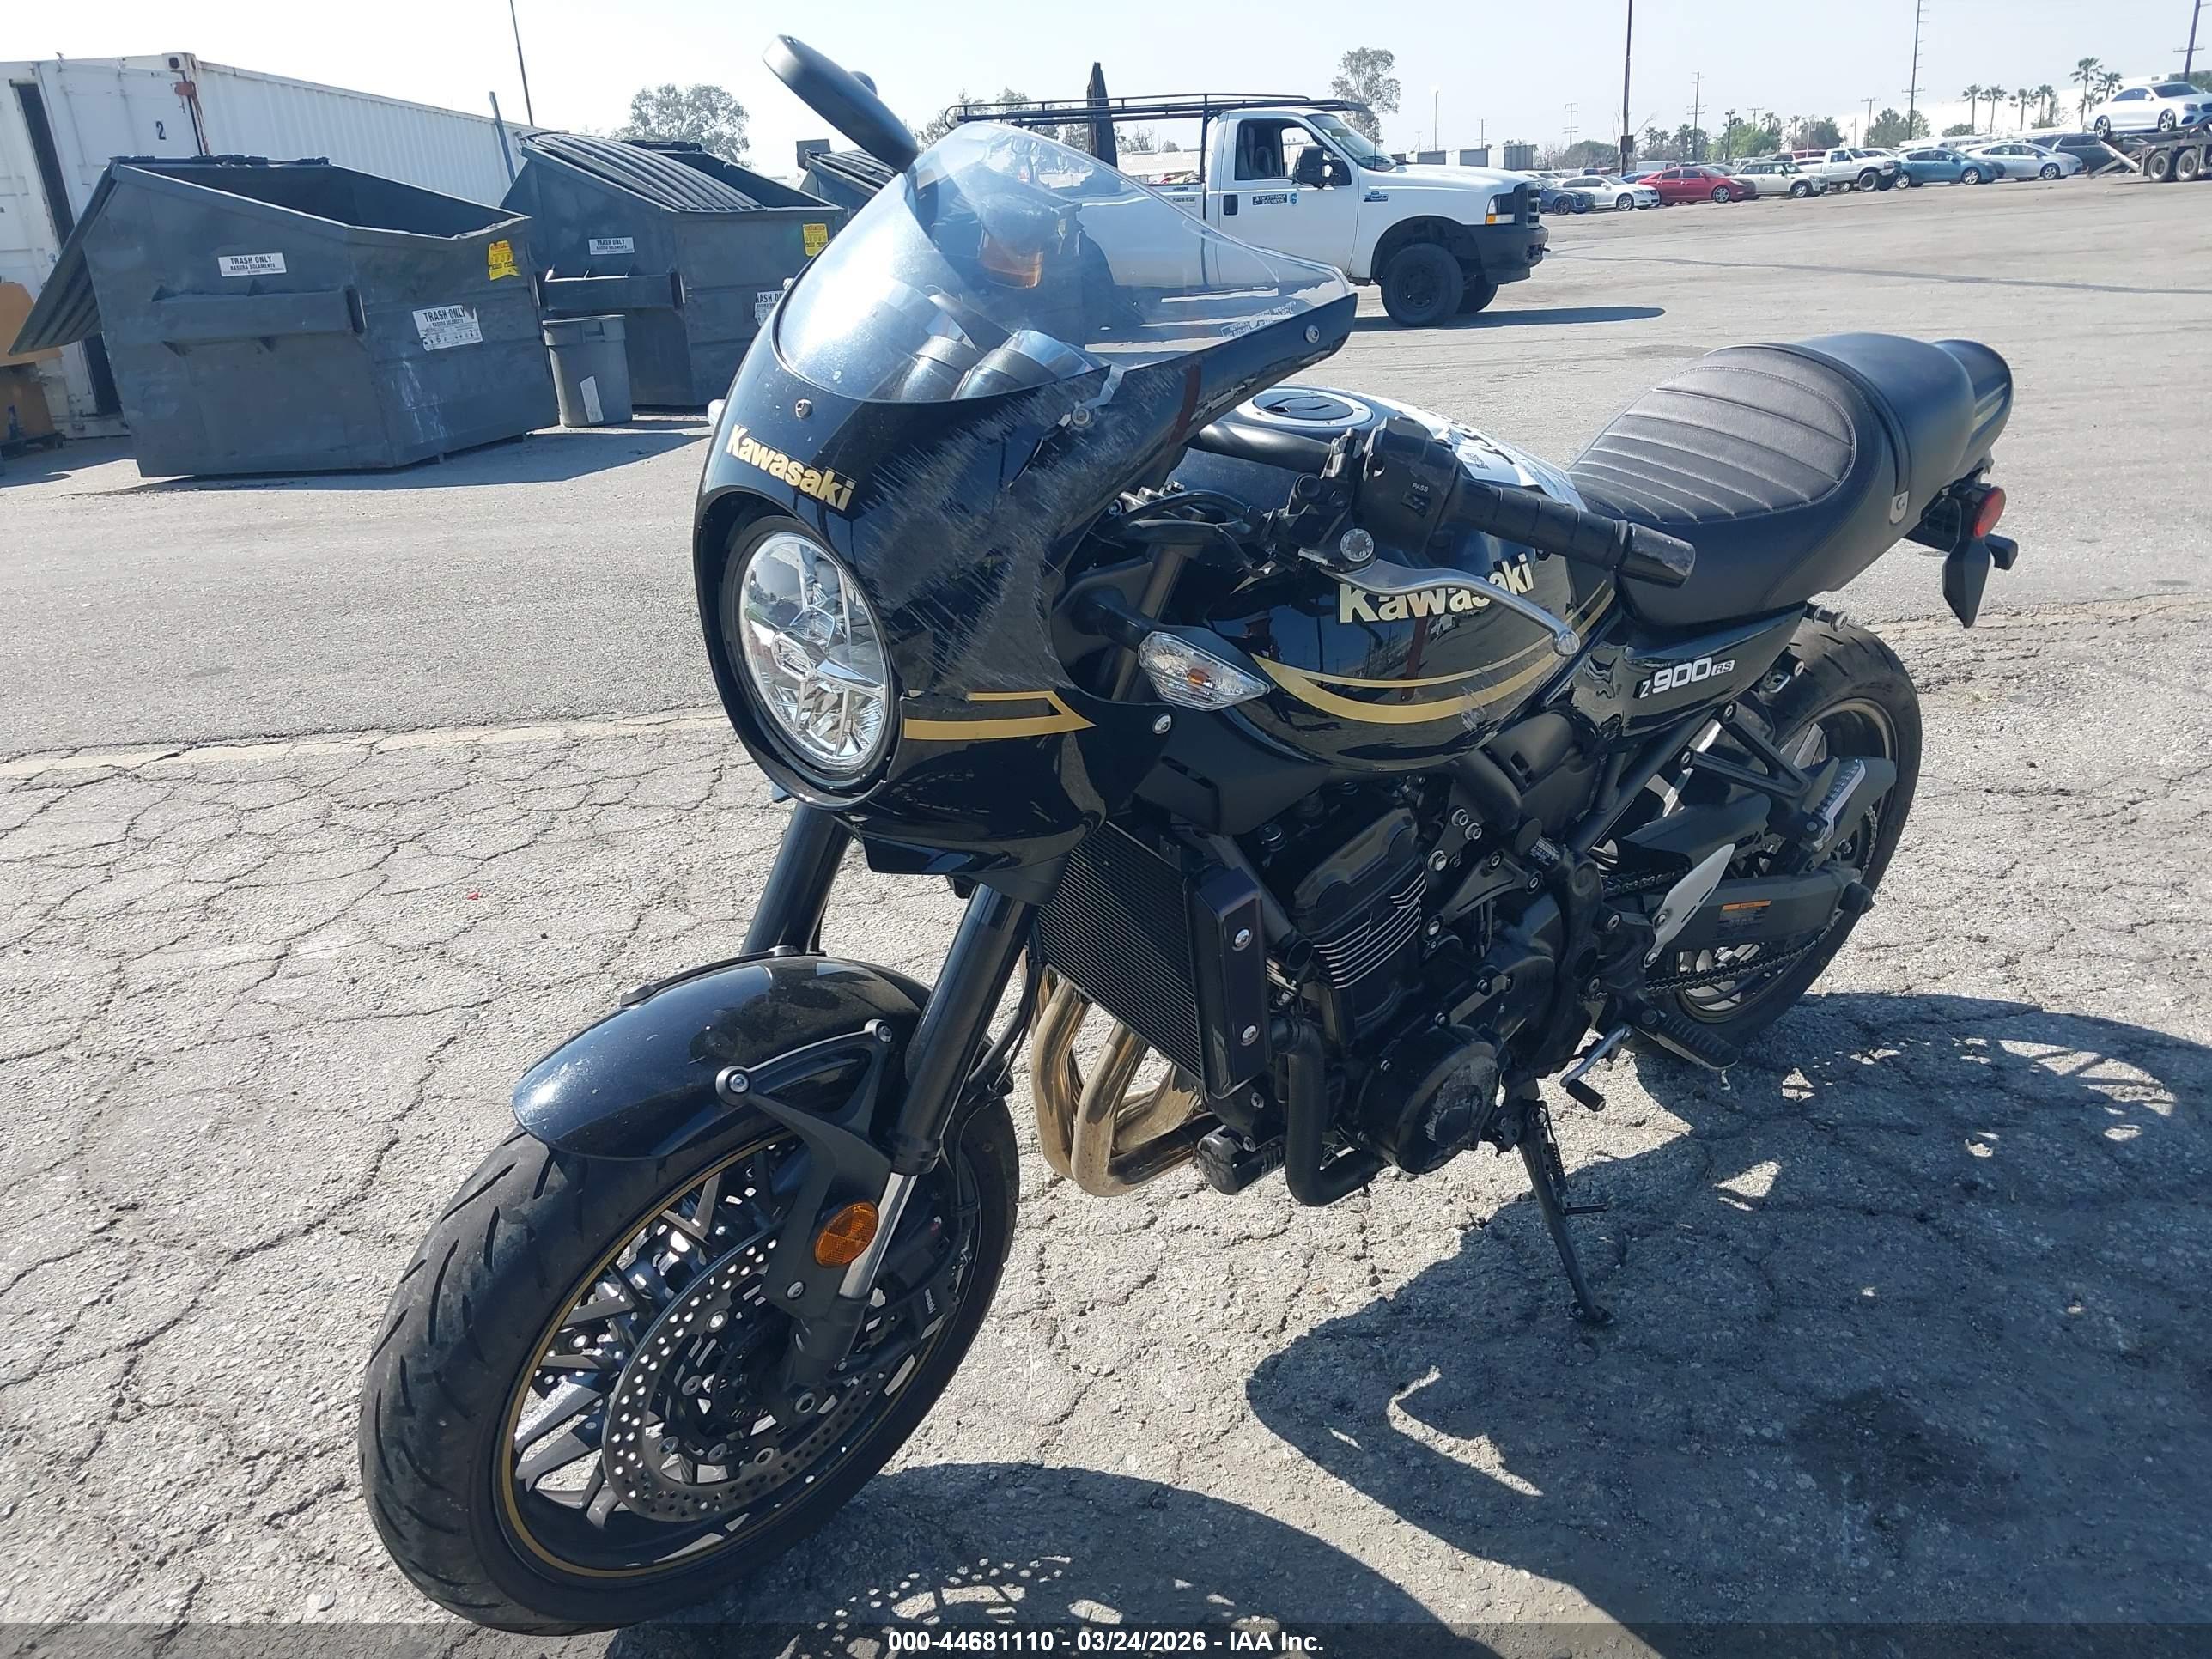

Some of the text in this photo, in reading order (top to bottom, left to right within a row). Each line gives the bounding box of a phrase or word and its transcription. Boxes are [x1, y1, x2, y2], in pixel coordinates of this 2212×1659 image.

[155, 120, 167, 140] 2
[230, 255, 272, 265] TRASH ONLY
[423, 307, 465, 323] TRASH ONLY
[726, 424, 855, 512] Kawasaki
[1412, 483, 1429, 493] PASS
